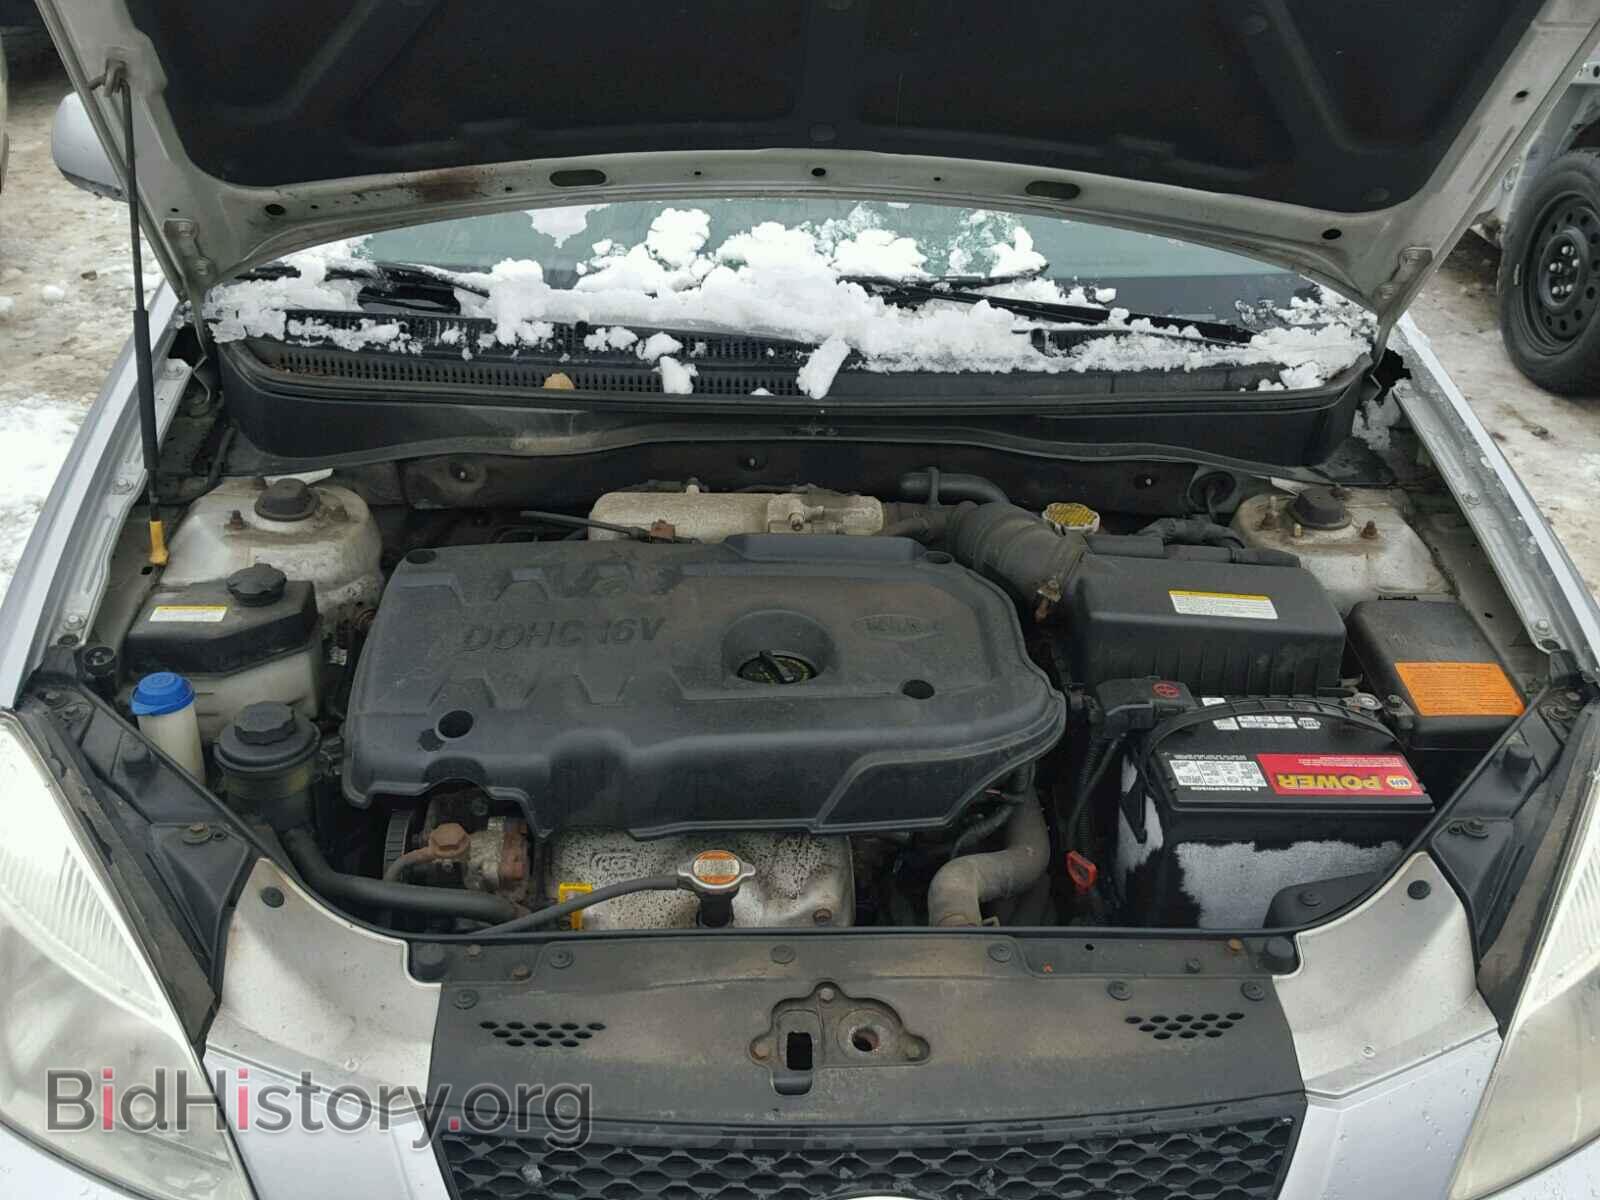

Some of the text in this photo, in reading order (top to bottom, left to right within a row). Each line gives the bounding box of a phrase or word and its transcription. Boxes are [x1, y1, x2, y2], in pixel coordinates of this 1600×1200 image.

[463, 616, 666, 651] DOHC 16V
[1277, 774, 1381, 791] POWER
